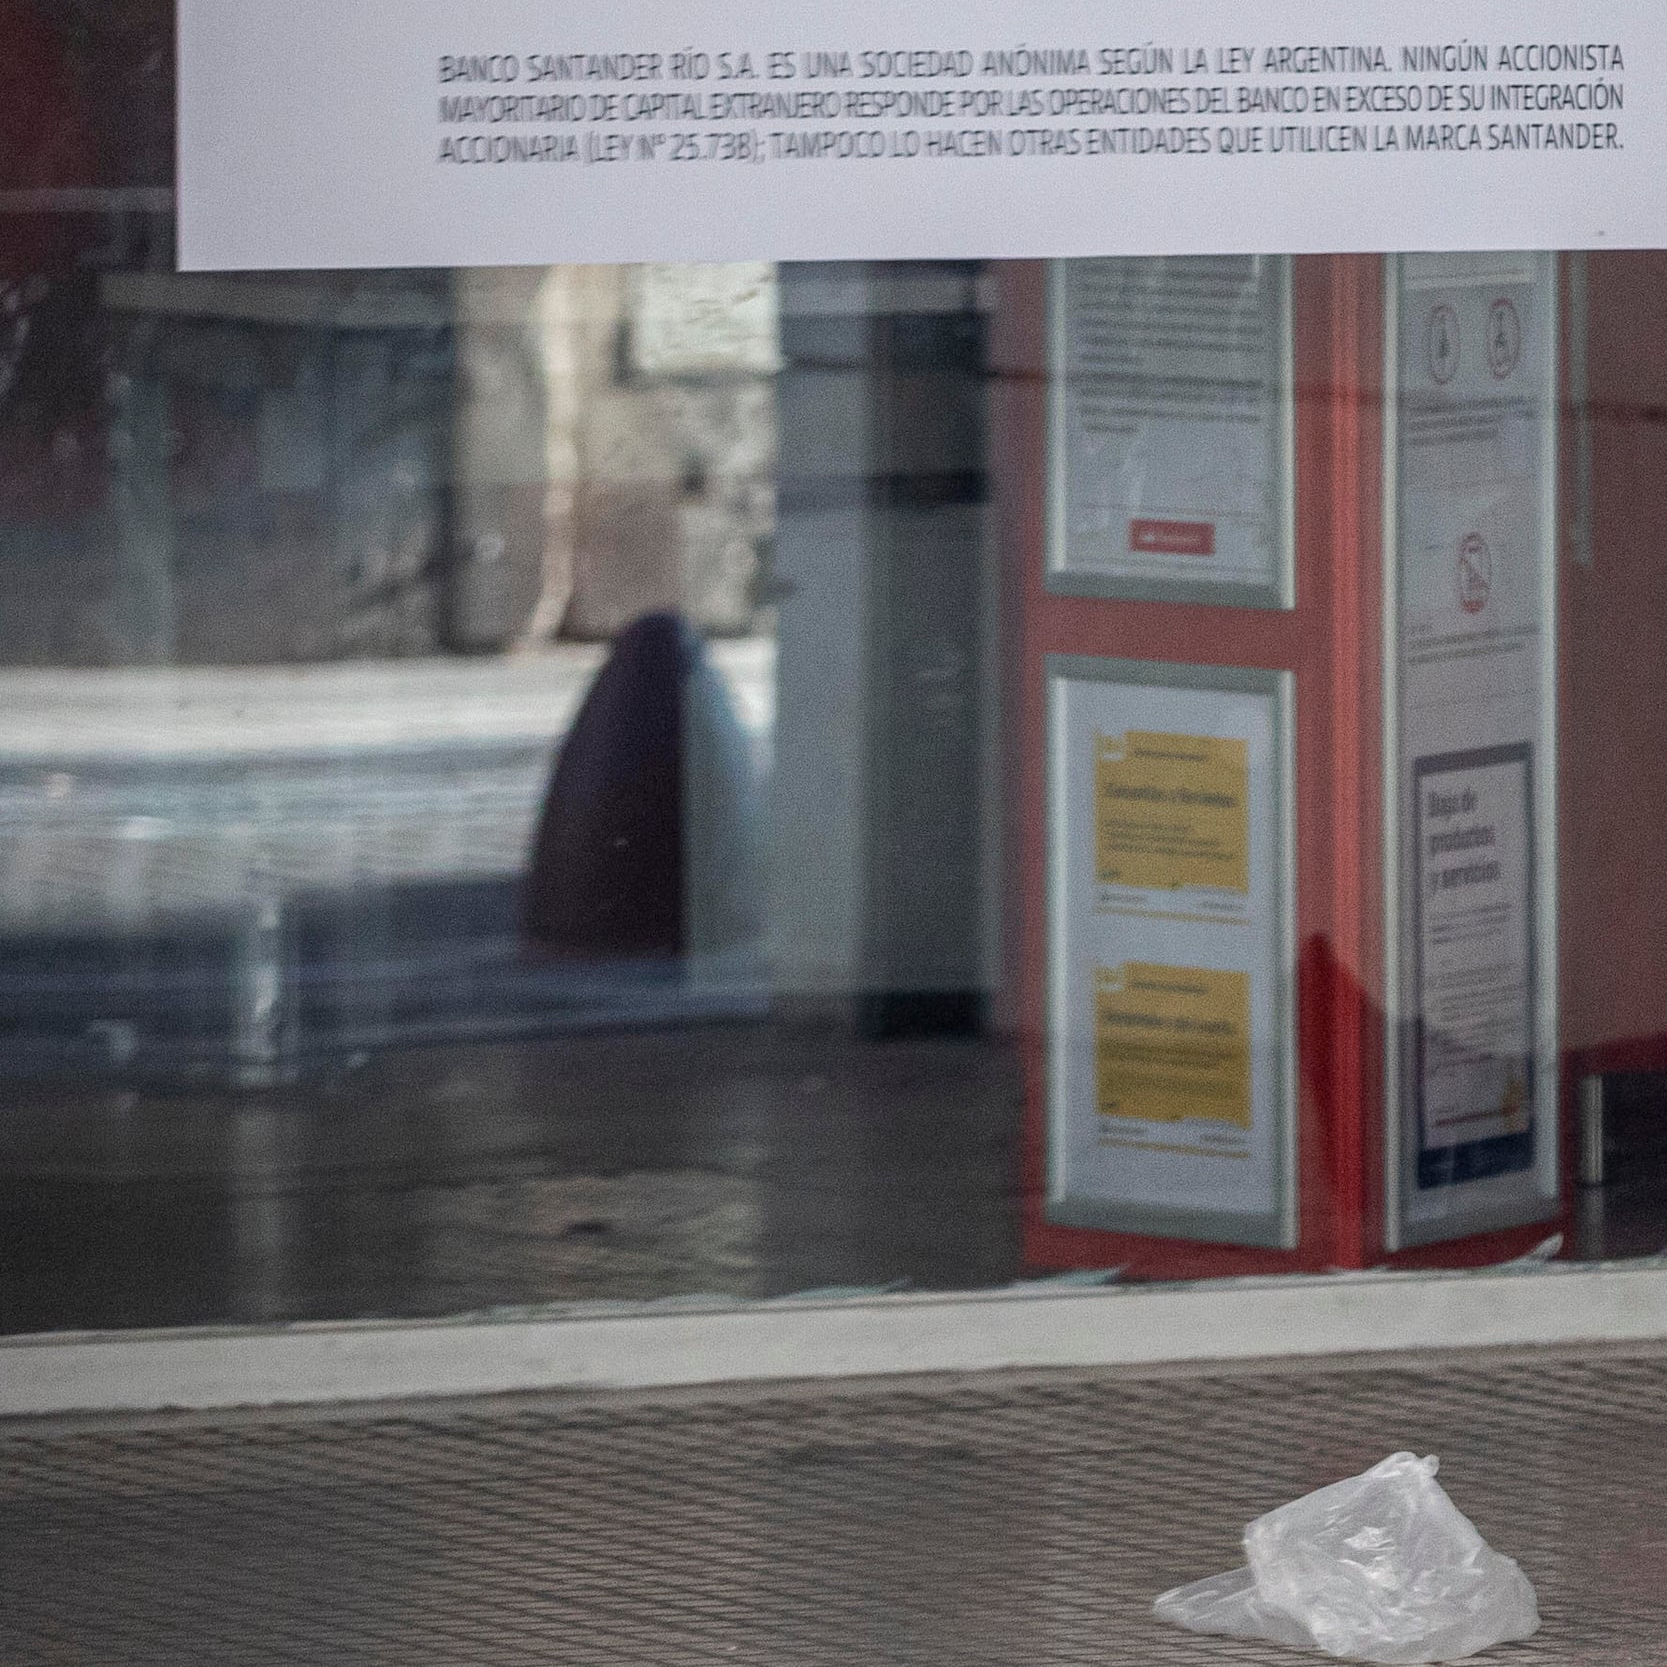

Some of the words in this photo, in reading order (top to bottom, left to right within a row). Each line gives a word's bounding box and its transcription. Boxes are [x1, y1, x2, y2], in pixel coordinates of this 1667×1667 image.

[439, 54, 520, 83] BANCO
[526, 52, 663, 82] SANTANDER
[671, 45, 710, 80] RÍO
[717, 51, 758, 80] S.A.
[767, 50, 797, 79] ES
[804, 49, 853, 79] UNA
[859, 49, 974, 79] SOCIEDAD
[981, 43, 1091, 77] ANÓNIMA
[1099, 41, 1174, 75] SEGÚN
[1184, 47, 1209, 75] LA
[1217, 47, 1255, 74] LEY
[1264, 45, 1393, 73] ARGENTINA.
[1402, 39, 1489, 73] NINGÚN
[1499, 43, 1625, 72] ACCIONISTA
[438, 93, 587, 123] MAYORITARIO
[589, 93, 618, 122] DE
[624, 92, 706, 121] CAPITAL
[710, 91, 841, 120] EXTRANJERO
[846, 90, 956, 119] RESPONDE
[960, 89, 1003, 118] POR
[1007, 89, 1045, 117] LAS
[1050, 88, 1192, 116] OPERACIONES
[1195, 87, 1233, 115] DEL
[1238, 86, 1310, 114] BANCO
[1313, 86, 1341, 113] EN
[1345, 85, 1423, 113] EXCESO
[1428, 84, 1453, 112] DE
[1459, 84, 1486, 111] SU
[1491, 77, 1625, 111] INTEGRACIÓN
[439, 134, 578, 163] ACCIONARIA
[589, 131, 636, 164] (LEY
[768, 130, 886, 159] TAMPOCO
[889, 130, 921, 158] LO
[926, 129, 1003, 157] HACEN
[1010, 128, 1083, 156] OTRAS
[1087, 126, 1212, 155] ENTIDADES
[1218, 126, 1264, 155] QUE
[1270, 125, 1368, 153] UTILICEN
[1373, 124, 1401, 152] LA
[1405, 123, 1483, 152] MARCA
[1487, 122, 1625, 151] SANTANDER.
